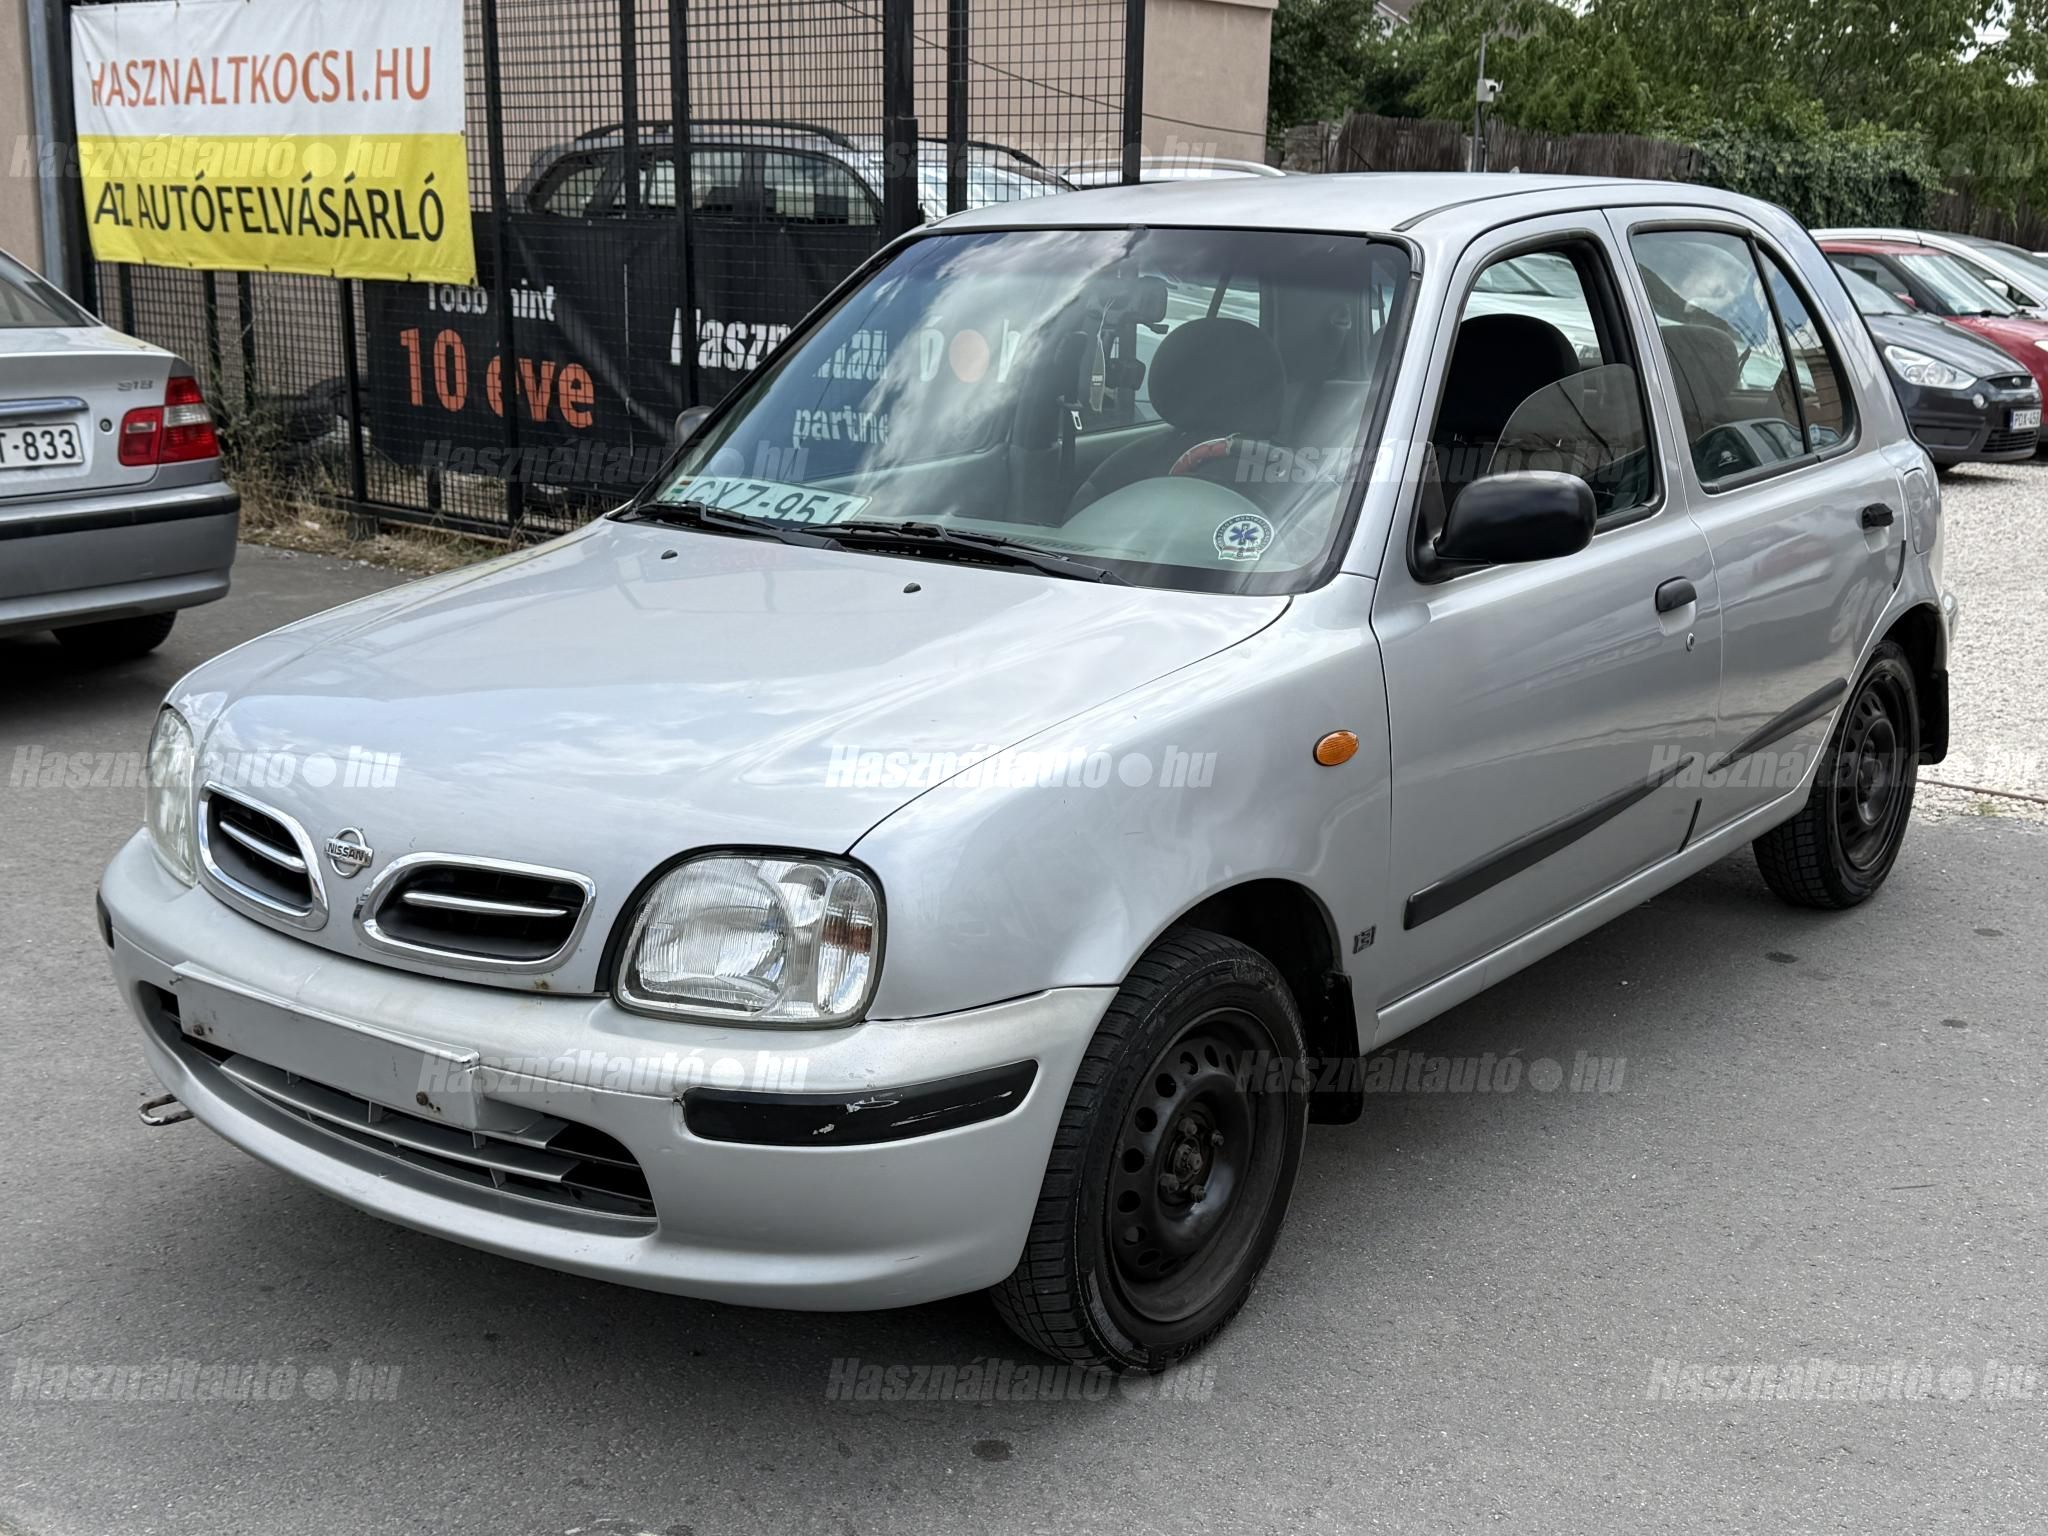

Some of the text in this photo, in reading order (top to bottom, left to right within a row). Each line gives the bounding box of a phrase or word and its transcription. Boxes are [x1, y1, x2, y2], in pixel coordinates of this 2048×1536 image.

[87, 46, 431, 107] HASZNALTKOCSI.HU
[94, 170, 445, 242] AZ AUTÓFELVÁSÁRLÓ
[400, 327, 468, 412] 10
[327, 842, 365, 862] NISSAN
